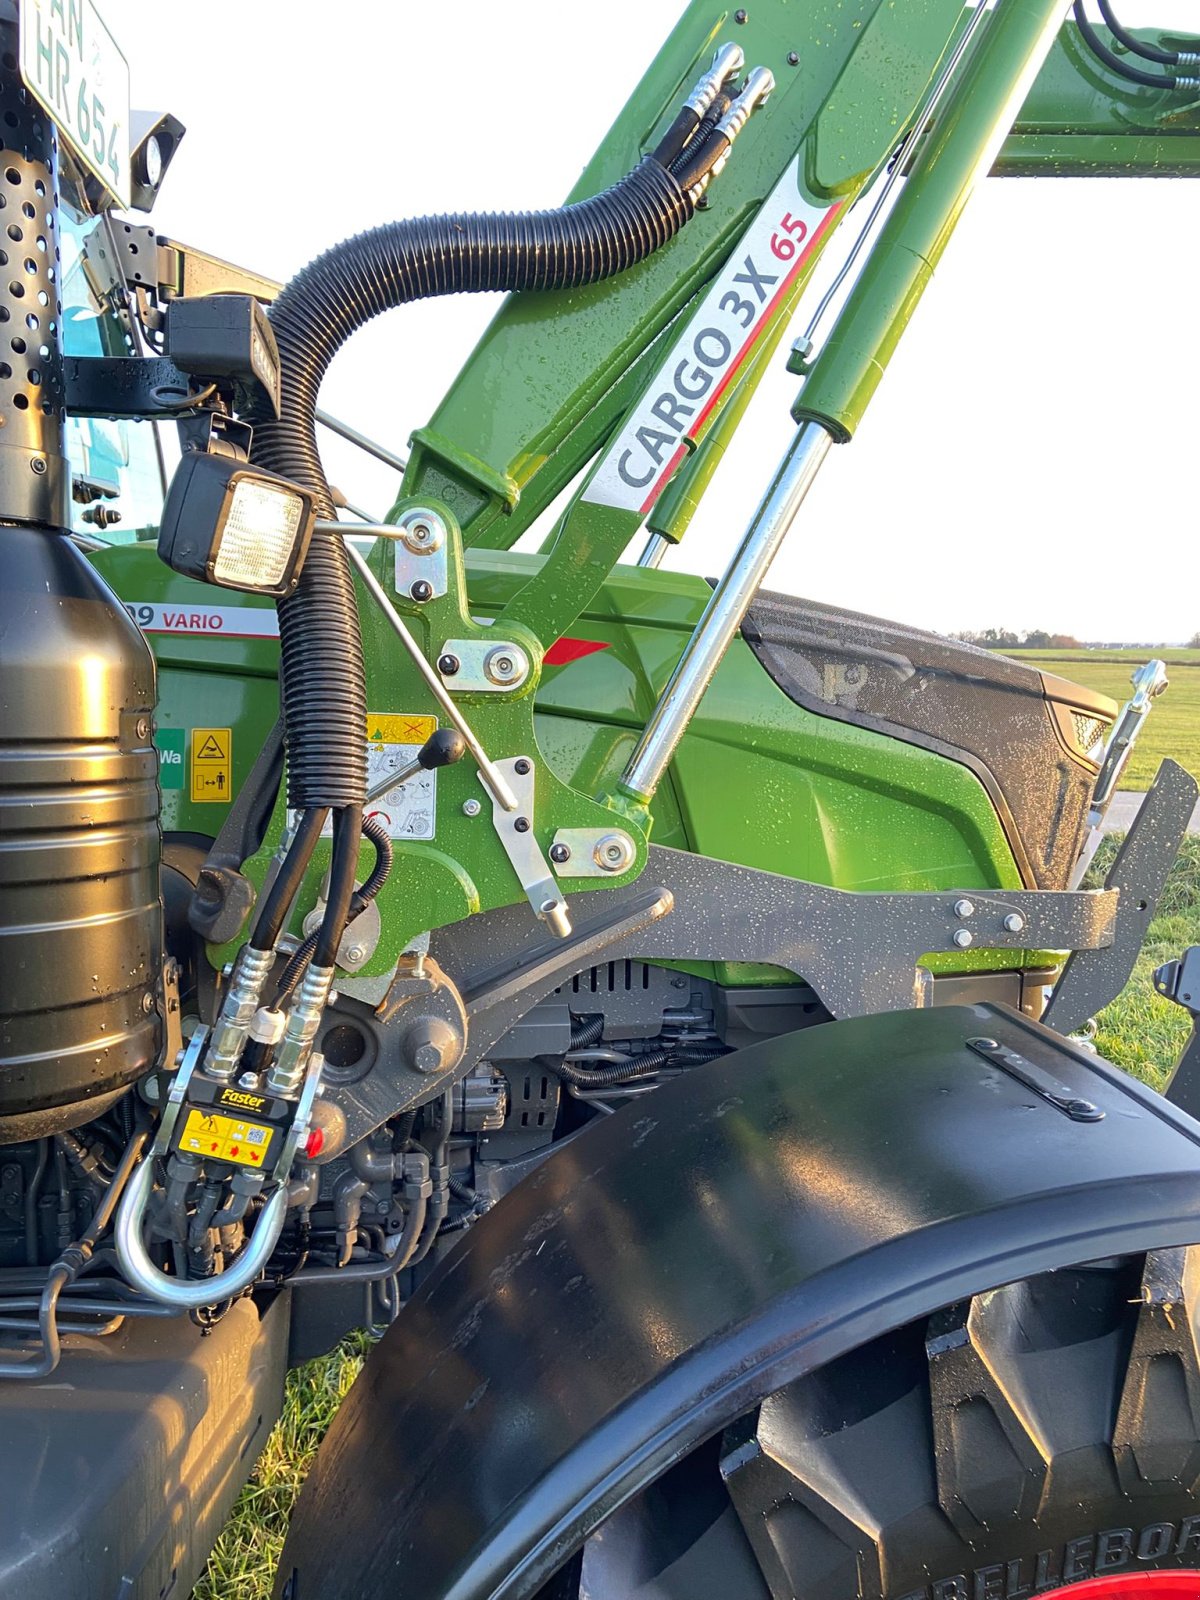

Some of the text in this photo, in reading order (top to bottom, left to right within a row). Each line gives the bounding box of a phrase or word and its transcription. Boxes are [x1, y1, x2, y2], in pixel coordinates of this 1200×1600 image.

[36, 10, 119, 186] HR 654
[617, 213, 807, 488] CARGO 3X 65
[162, 613, 223, 629] VARIO
[222, 1088, 265, 1107] Faster
